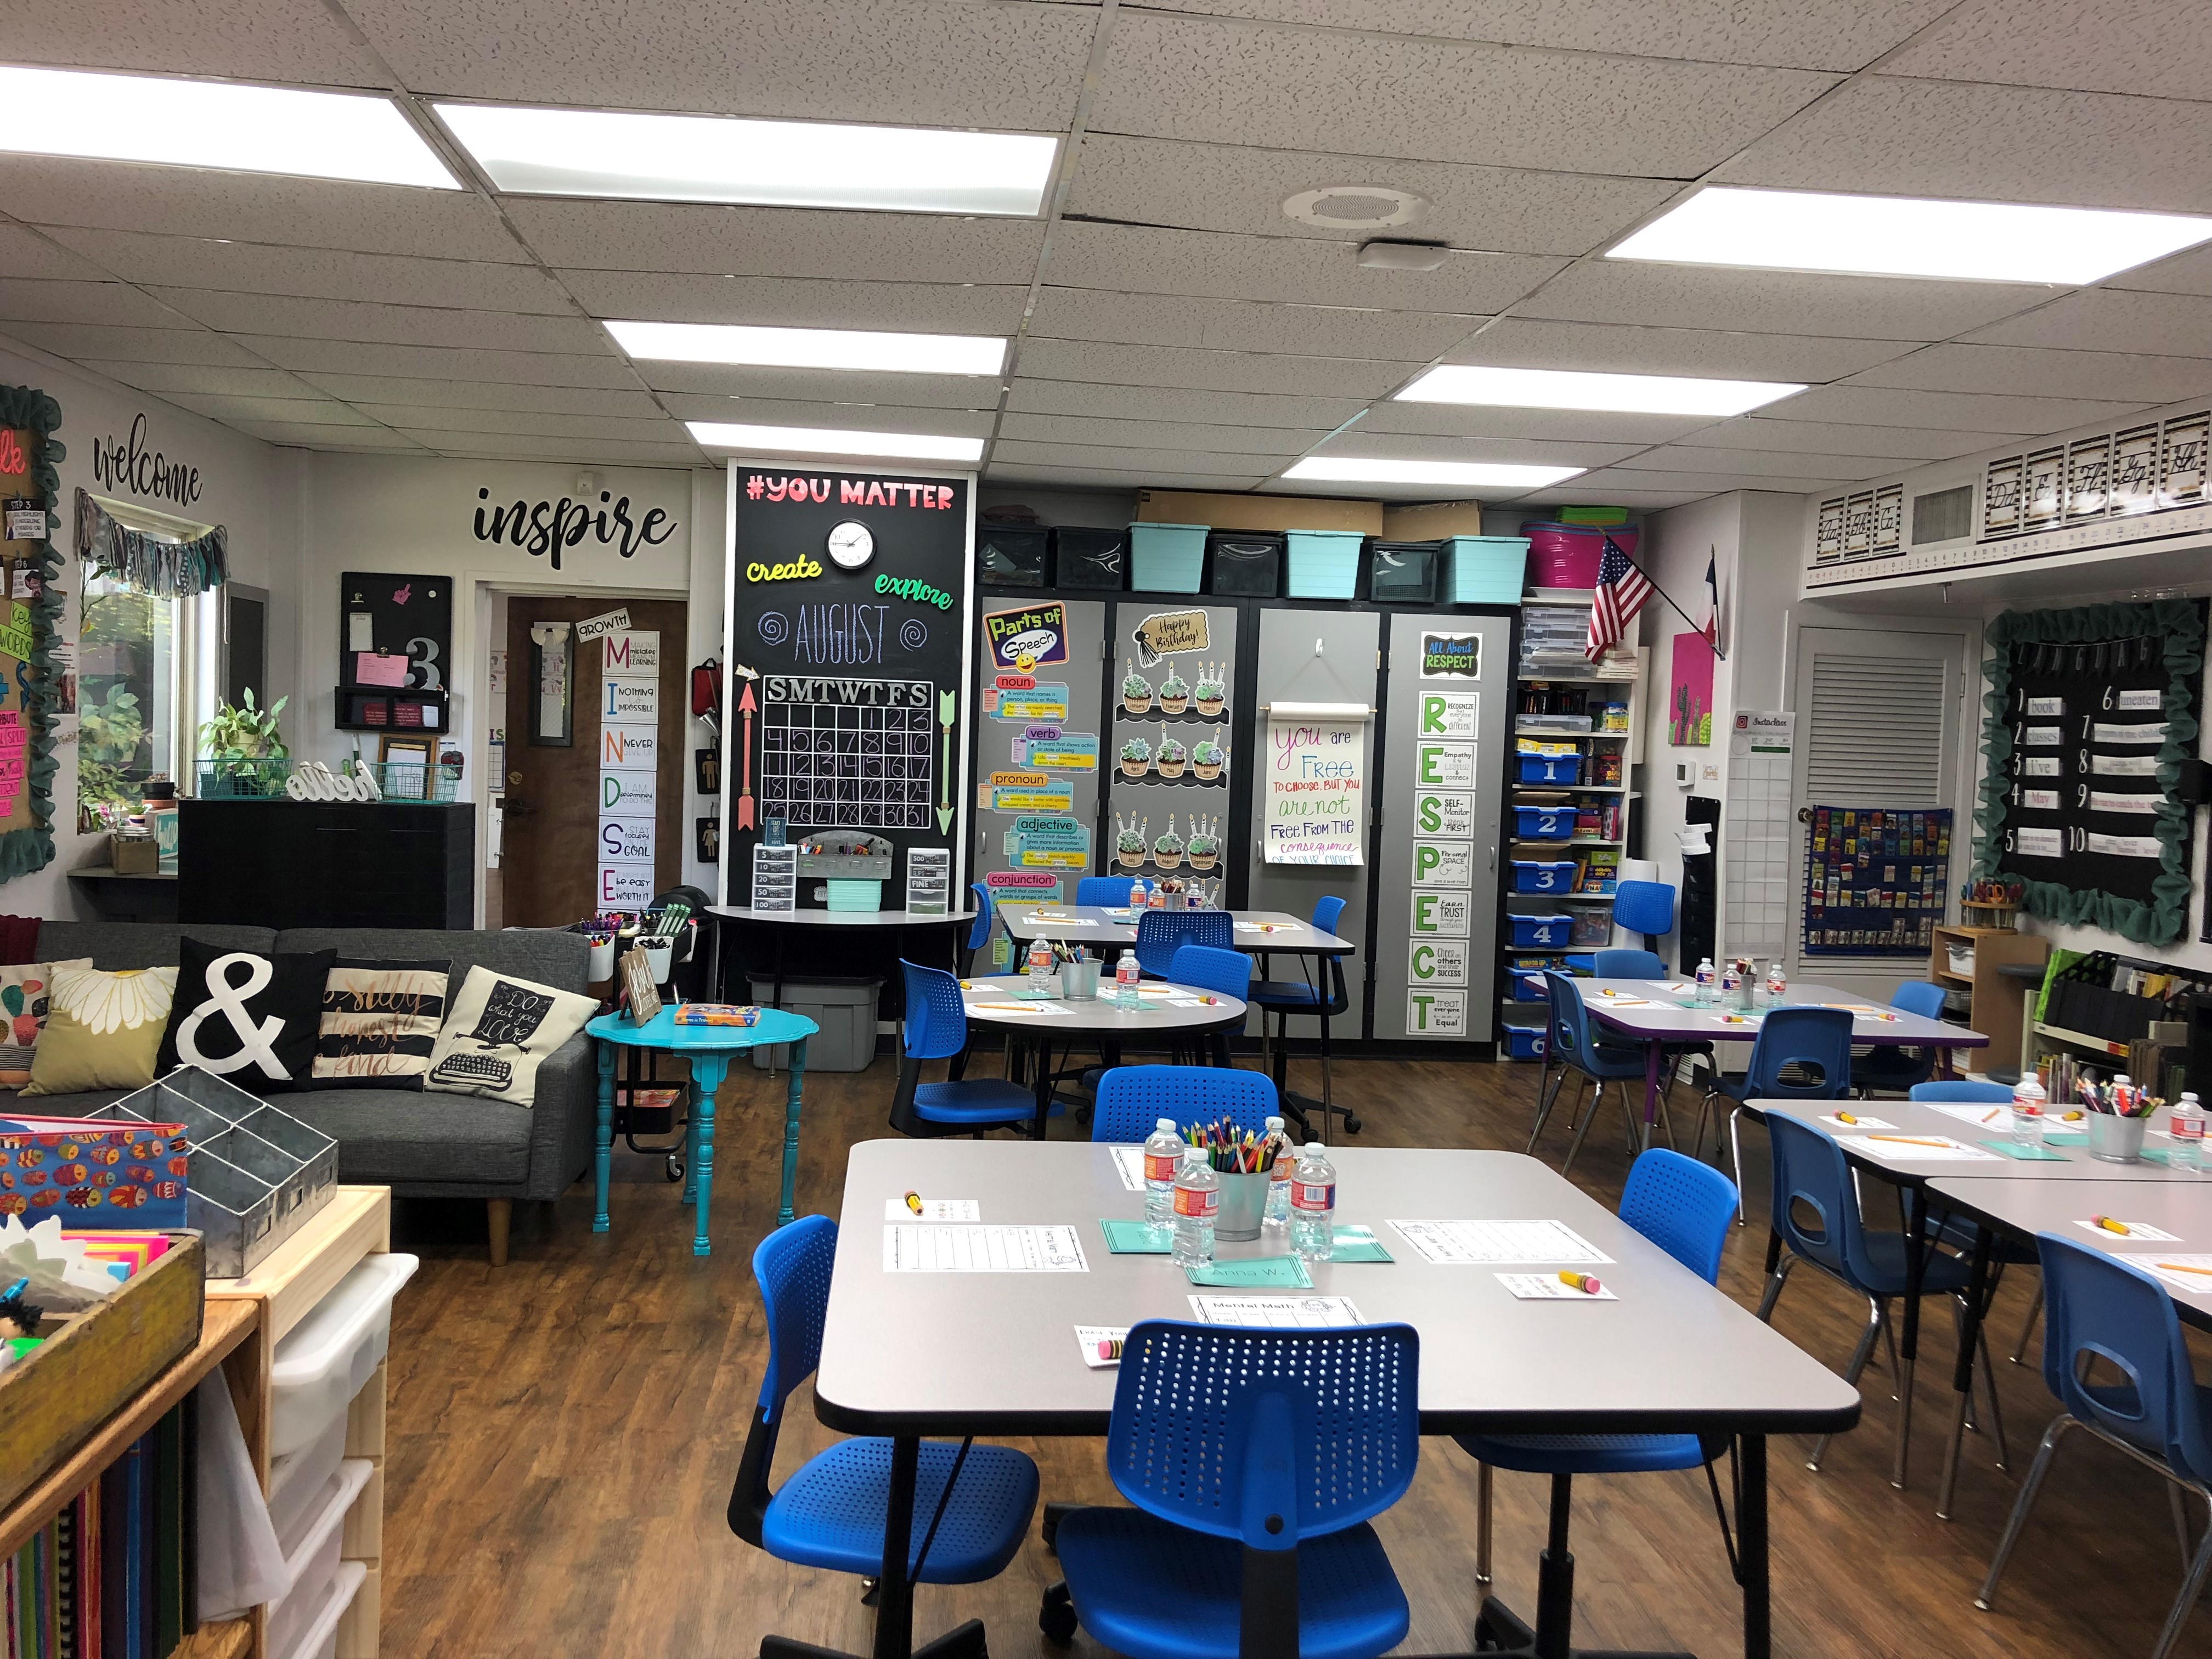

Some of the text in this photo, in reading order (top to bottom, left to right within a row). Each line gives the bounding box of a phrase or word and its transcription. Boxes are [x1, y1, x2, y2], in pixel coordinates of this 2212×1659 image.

[94, 414, 202, 506] welcome
[747, 475, 954, 510] #YOU MATTER
[11, 500, 31, 510] STEP 3
[474, 488, 678, 570] inspire
[747, 554, 822, 582] create
[874, 574, 953, 610] explore
[794, 603, 891, 664] AUGUST
[989, 608, 1061, 641] Parts of
[1159, 619, 1191, 633] Happy
[1005, 631, 1054, 658] Speech
[1155, 629, 1200, 650] Birthday!
[1429, 641, 1474, 654] All About
[403, 637, 441, 690] 3
[607, 636, 629, 669] M
[1426, 654, 1475, 669] RESPECT
[618, 687, 654, 696] NOTHING
[1002, 678, 1030, 687] noun
[618, 704, 654, 713] IMPOSSIBLE
[2032, 699, 2055, 713] book
[2102, 685, 2112, 710] 6
[870, 709, 929, 731] 1 2 3
[1424, 697, 1447, 733] R
[1752, 717, 1787, 726] Instaclass
[1030, 728, 1056, 738] verb
[606, 731, 653, 763] N NEVER
[1276, 727, 1351, 771] you are
[766, 753, 928, 778] 11 12 13 14 15 16 17
[1421, 747, 1444, 783] E
[1543, 761, 1556, 780] 1
[2013, 753, 2022, 776] 3
[996, 775, 1044, 785] pronoun
[1324, 779, 1342, 790] BUT
[1344, 778, 1360, 793] YOU
[604, 777, 621, 808] D
[2011, 783, 2019, 806] 4
[2078, 783, 2087, 808] 9
[789, 803, 811, 823] 26
[814, 803, 834, 824] 27
[838, 804, 859, 825] 28
[861, 804, 882, 825] 29
[884, 805, 905, 826] 30
[907, 805, 924, 827] 31
[1279, 795, 1350, 817] are not
[1419, 797, 1470, 832] S SELF- Monitor
[1021, 818, 1073, 832] adjective
[1303, 822, 1329, 837] FROM
[1538, 815, 1557, 832] 2
[602, 823, 624, 855] S
[624, 845, 650, 857] GOAL
[1280, 842, 1359, 856] consequence
[2005, 829, 2013, 852] 5
[2069, 826, 2085, 852] 10
[1417, 846, 1440, 880] P
[603, 870, 616, 901] E
[616, 877, 627, 885] be
[991, 874, 1052, 886] conjunction
[1536, 870, 1554, 888] 3
[616, 892, 650, 902] WORTH IT
[1416, 895, 1465, 932] E TRUST
[1533, 925, 1551, 943] 4
[1413, 945, 1436, 979] C
[338, 972, 435, 1032] silly
[508, 991, 539, 1009] DO
[488, 1004, 537, 1026] what you
[1413, 996, 1435, 1030] T
[1436, 1000, 1459, 1008] treat
[1436, 1019, 1458, 1028] Equal
[1531, 1036, 1545, 1054] 6
[1212, 1267, 1257, 1278] Anna
[1213, 1301, 1257, 1310] Mental
